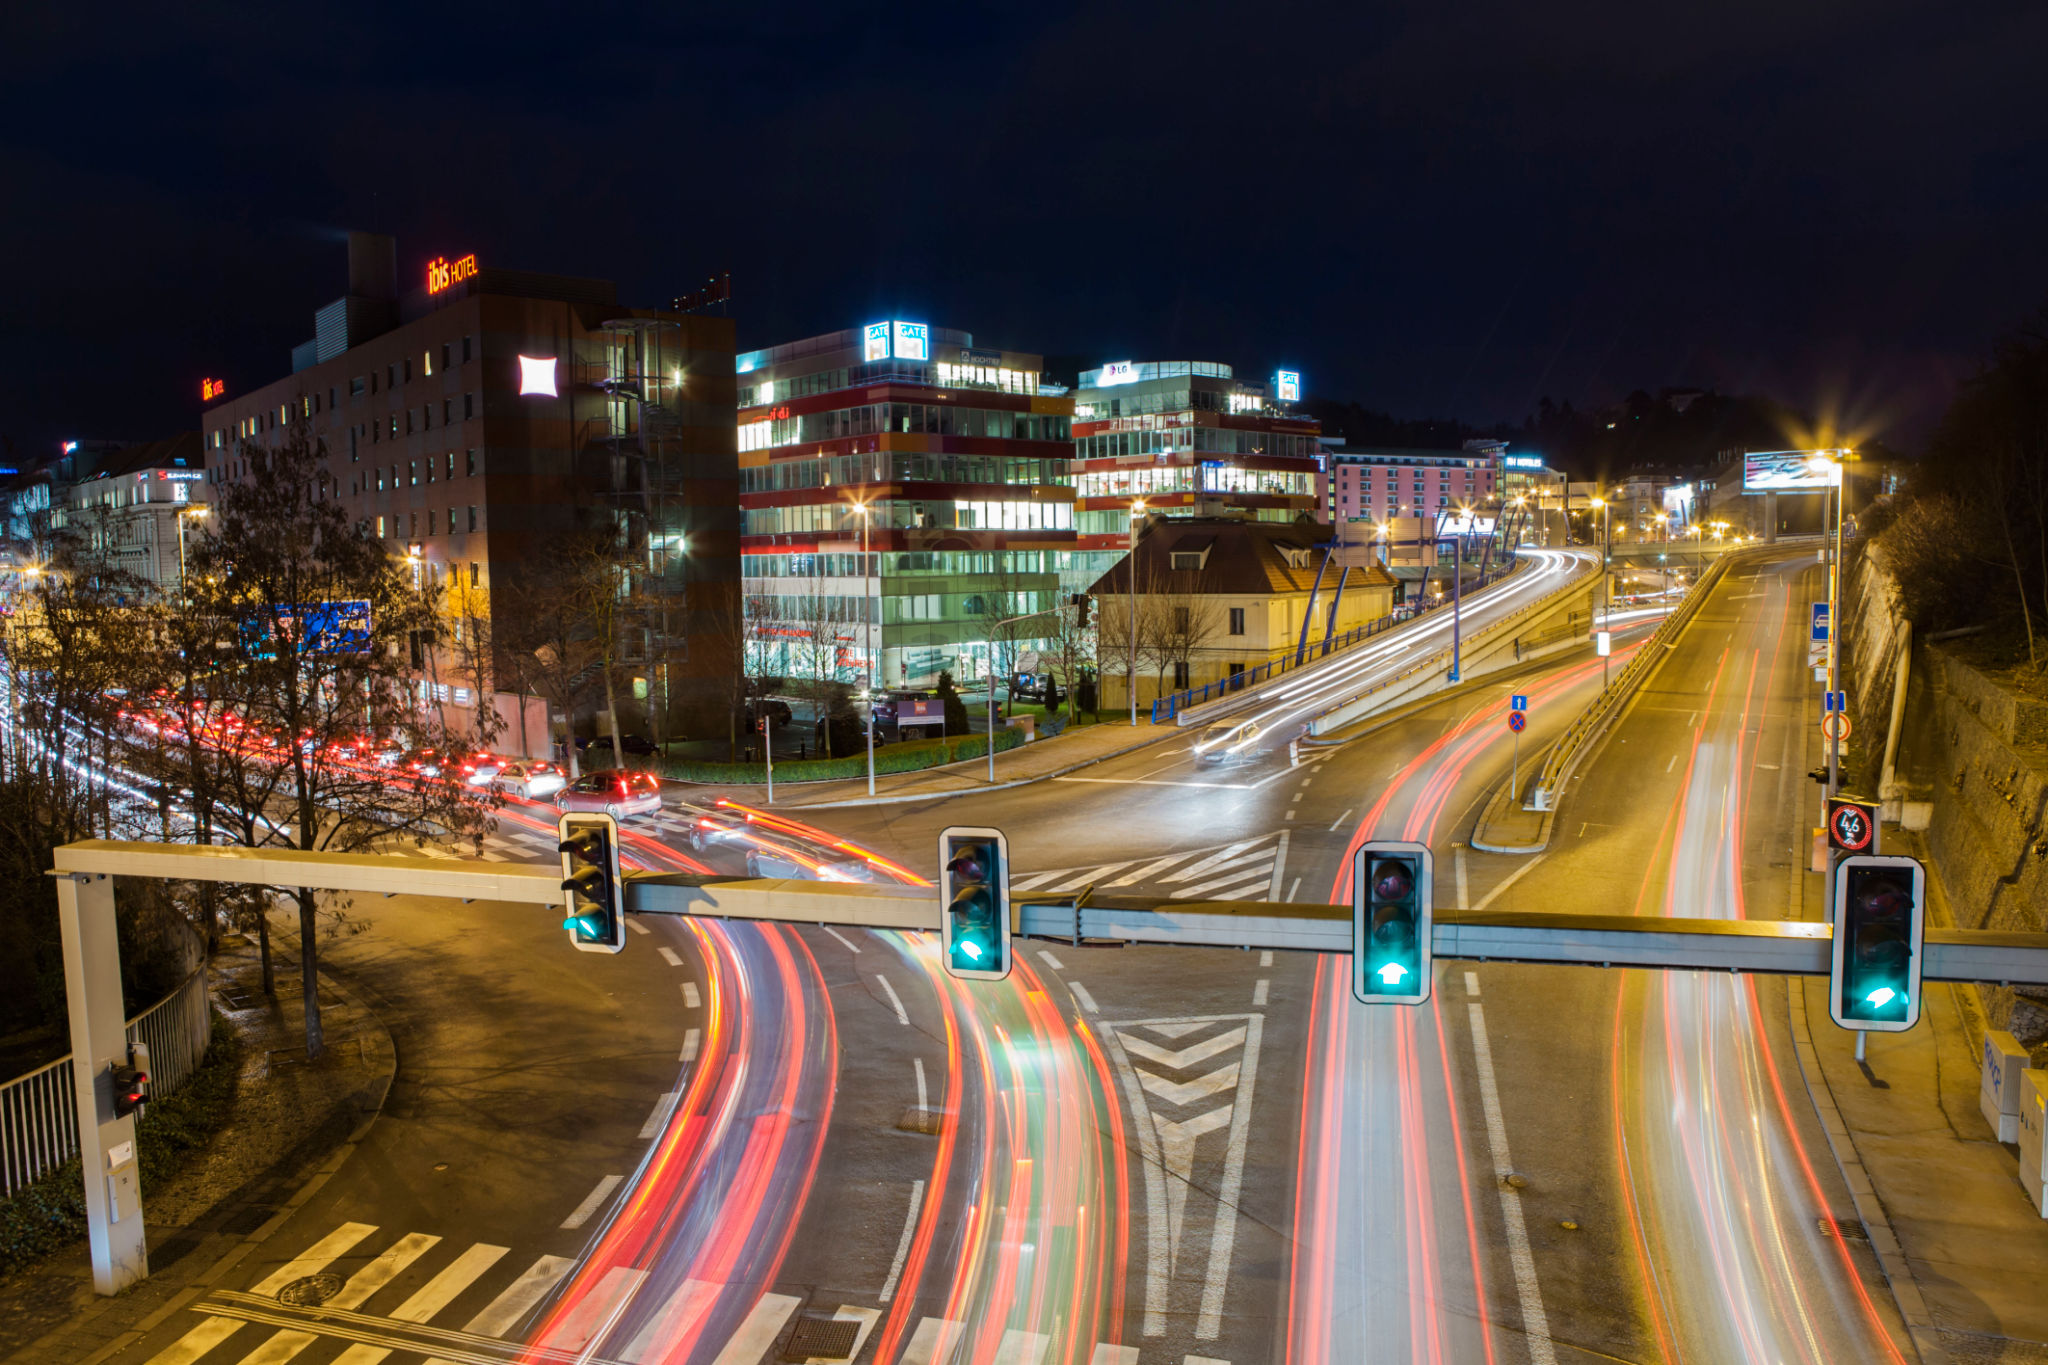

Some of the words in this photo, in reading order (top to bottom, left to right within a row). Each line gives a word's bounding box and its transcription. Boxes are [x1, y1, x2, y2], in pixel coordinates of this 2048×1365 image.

[428, 256, 449, 295] ibis
[450, 253, 478, 285] HOTEL
[868, 325, 888, 339] GATE
[901, 326, 926, 338] GATE
[1117, 365, 1128, 374] LG
[202, 377, 213, 401] ibis
